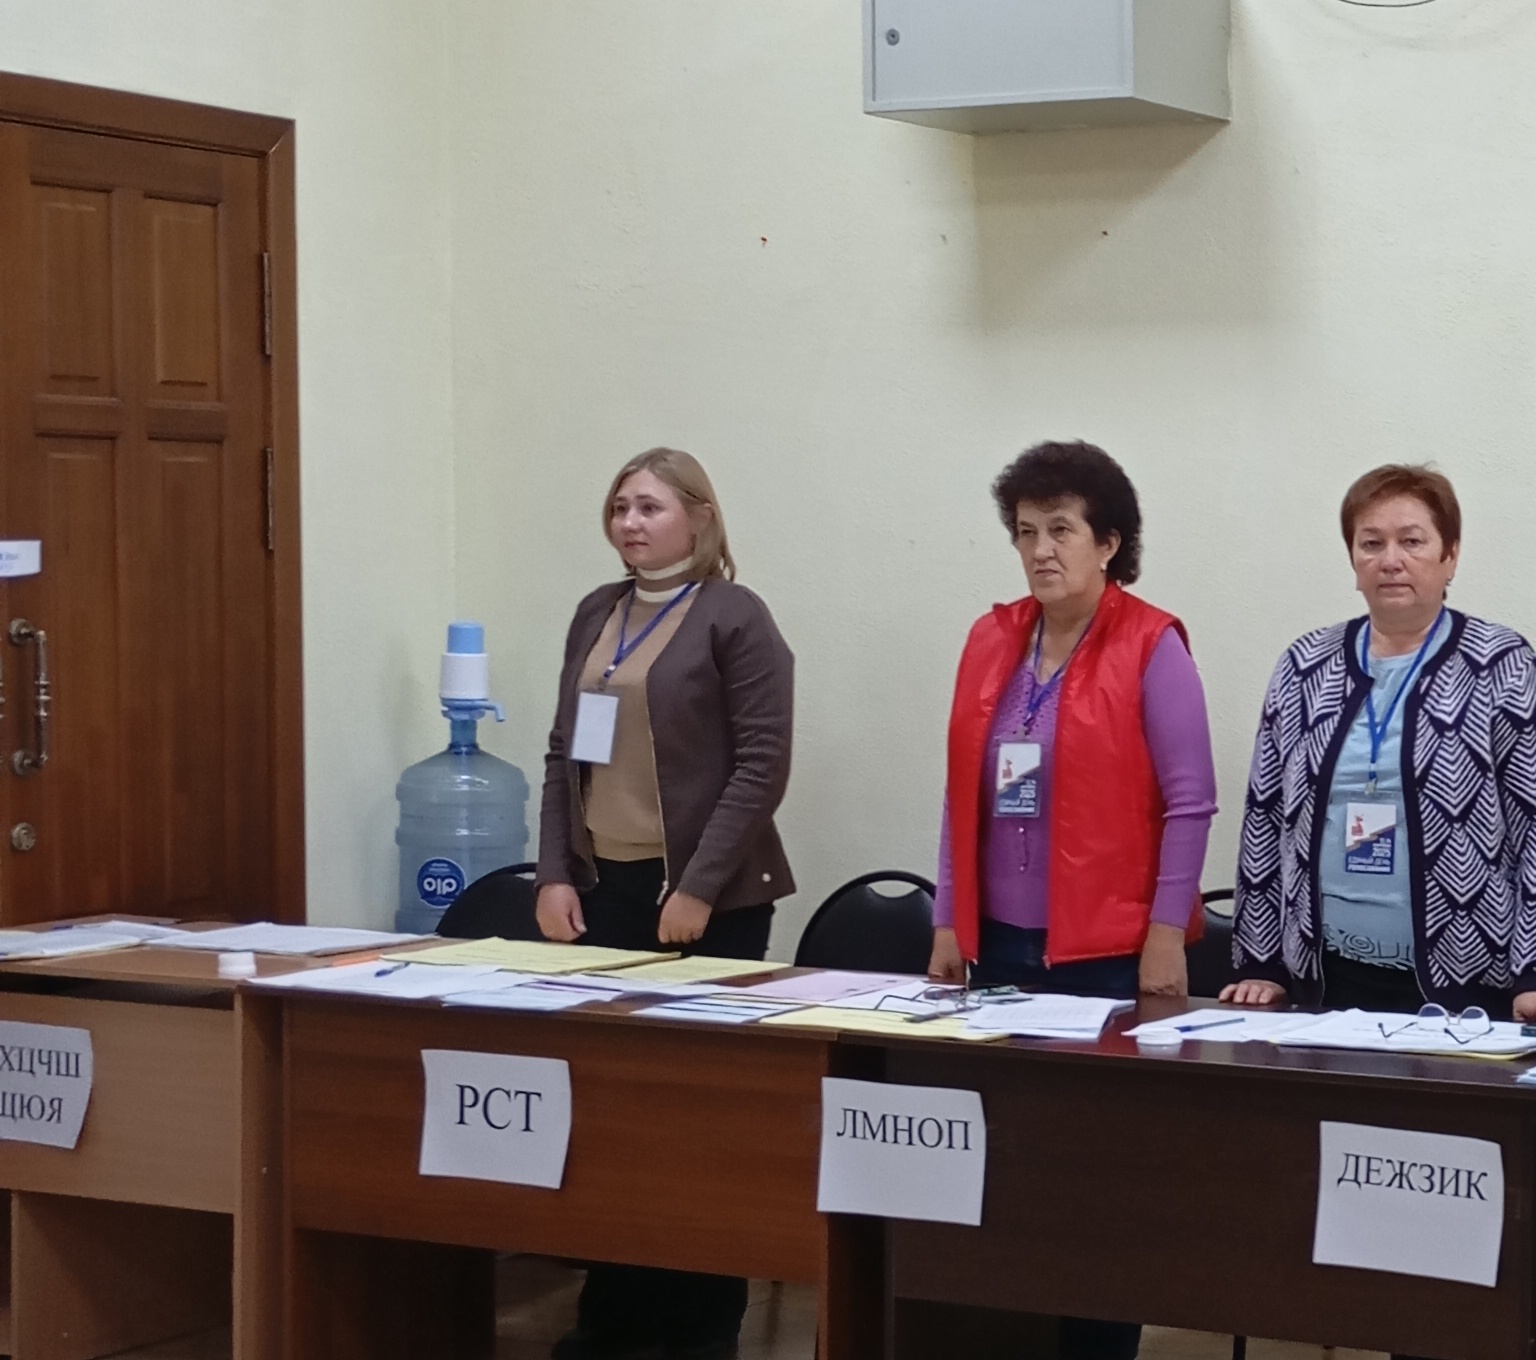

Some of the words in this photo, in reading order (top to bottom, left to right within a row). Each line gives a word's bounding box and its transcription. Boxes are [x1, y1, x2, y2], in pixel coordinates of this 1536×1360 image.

[454, 1083, 542, 1133] РСТ
[836, 1107, 972, 1151] ЛМНОП
[1336, 1152, 1489, 1202] ДЕЖЗИК
